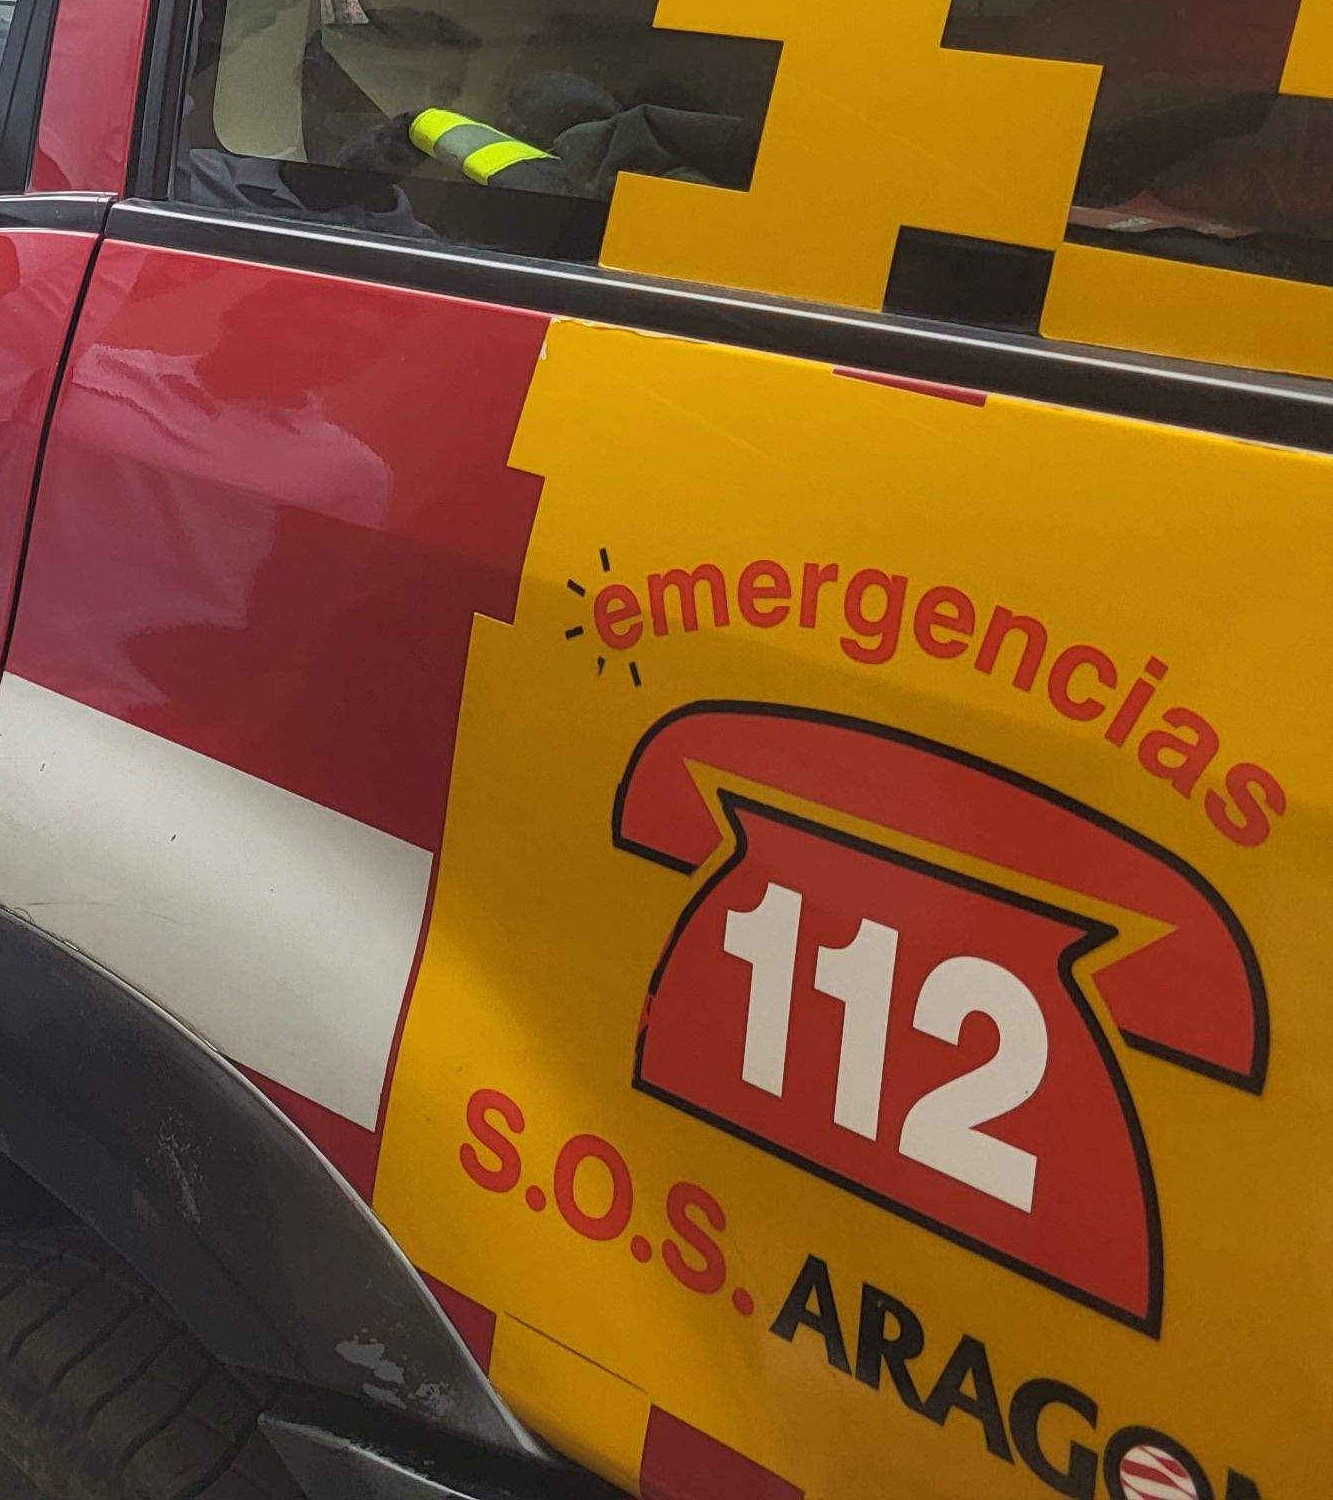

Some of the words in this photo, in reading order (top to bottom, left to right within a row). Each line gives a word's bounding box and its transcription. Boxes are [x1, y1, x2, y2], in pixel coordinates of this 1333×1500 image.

[593, 559, 1287, 848] emergencias
[723, 881, 1048, 1214] 112
[459, 1088, 755, 1317] S.O.S.
